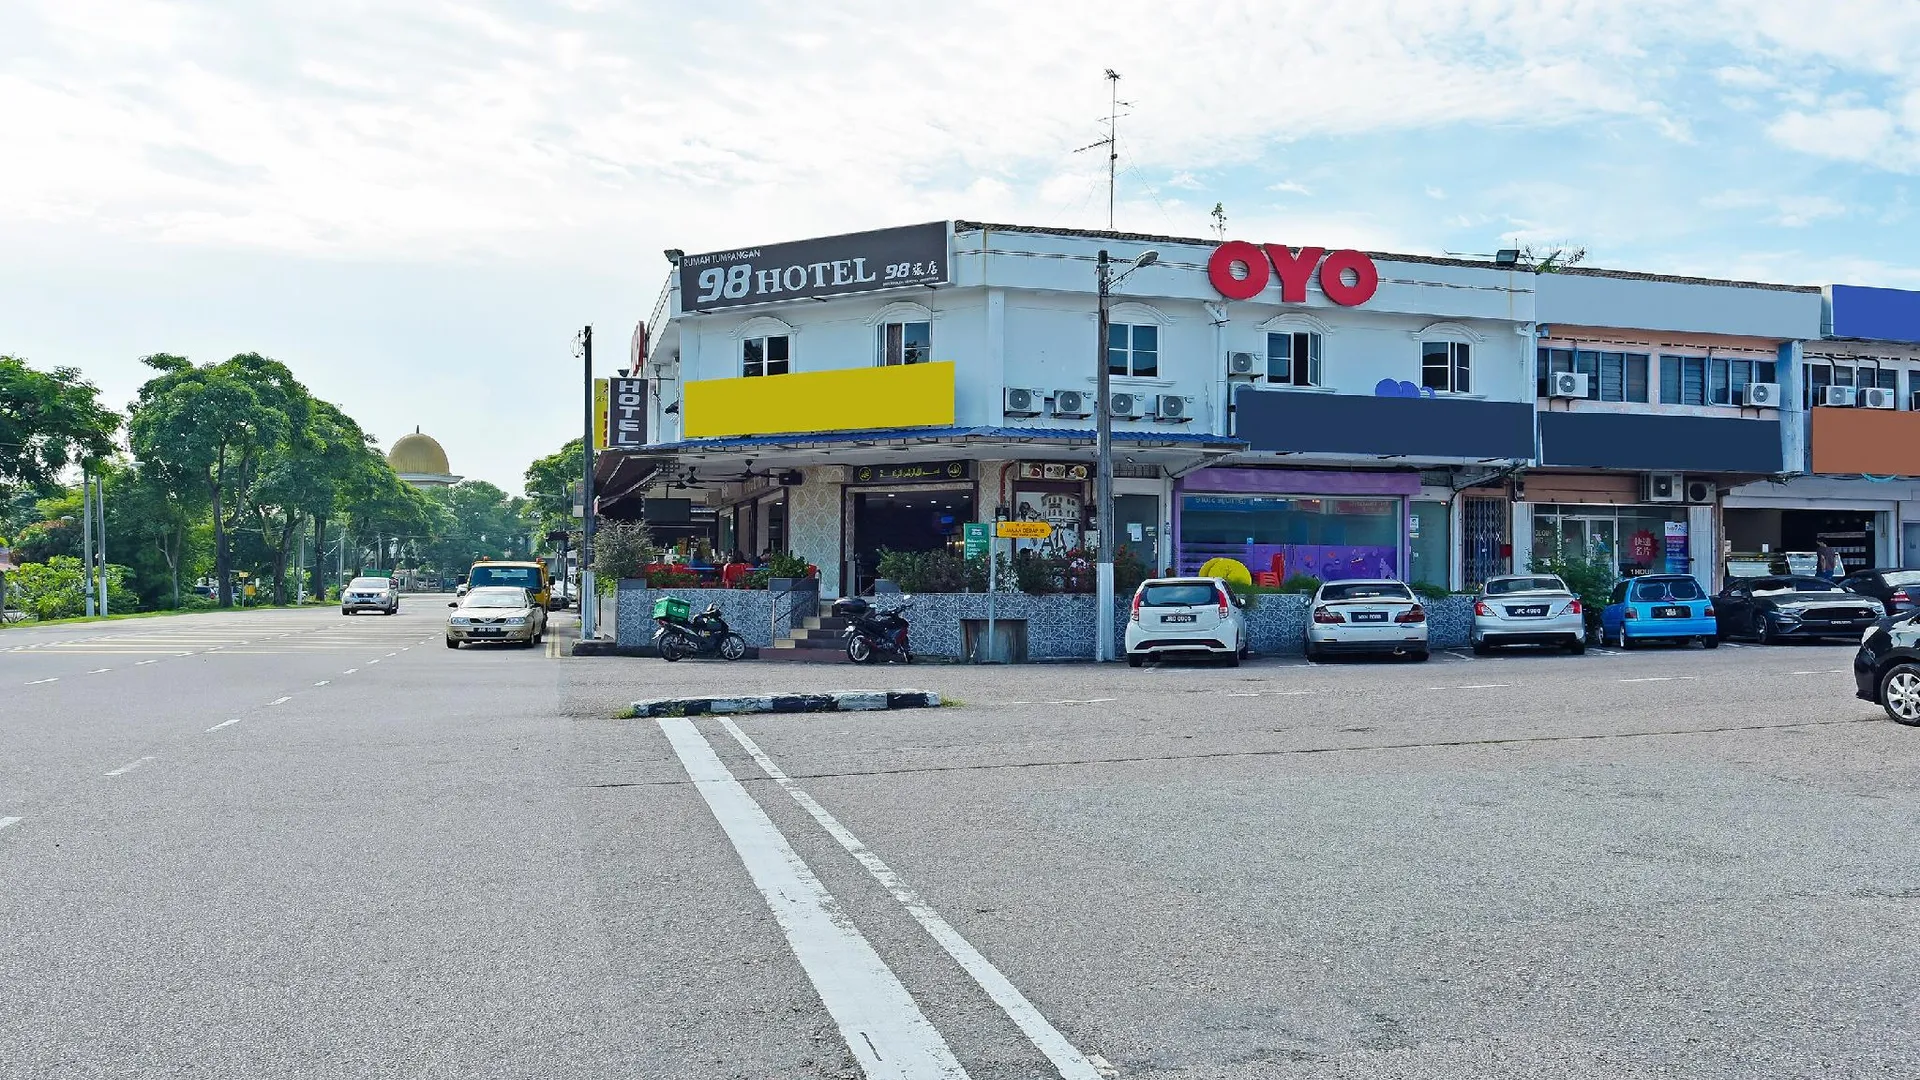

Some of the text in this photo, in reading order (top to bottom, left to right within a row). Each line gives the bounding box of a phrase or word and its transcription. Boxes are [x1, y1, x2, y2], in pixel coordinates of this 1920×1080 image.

[683, 249, 760, 267] RUMAH TUMPANGAN
[697, 257, 876, 303] 98 HOTEL
[884, 262, 910, 280] 98
[1207, 240, 1378, 307] OYO
[618, 380, 640, 444] HOTEL
